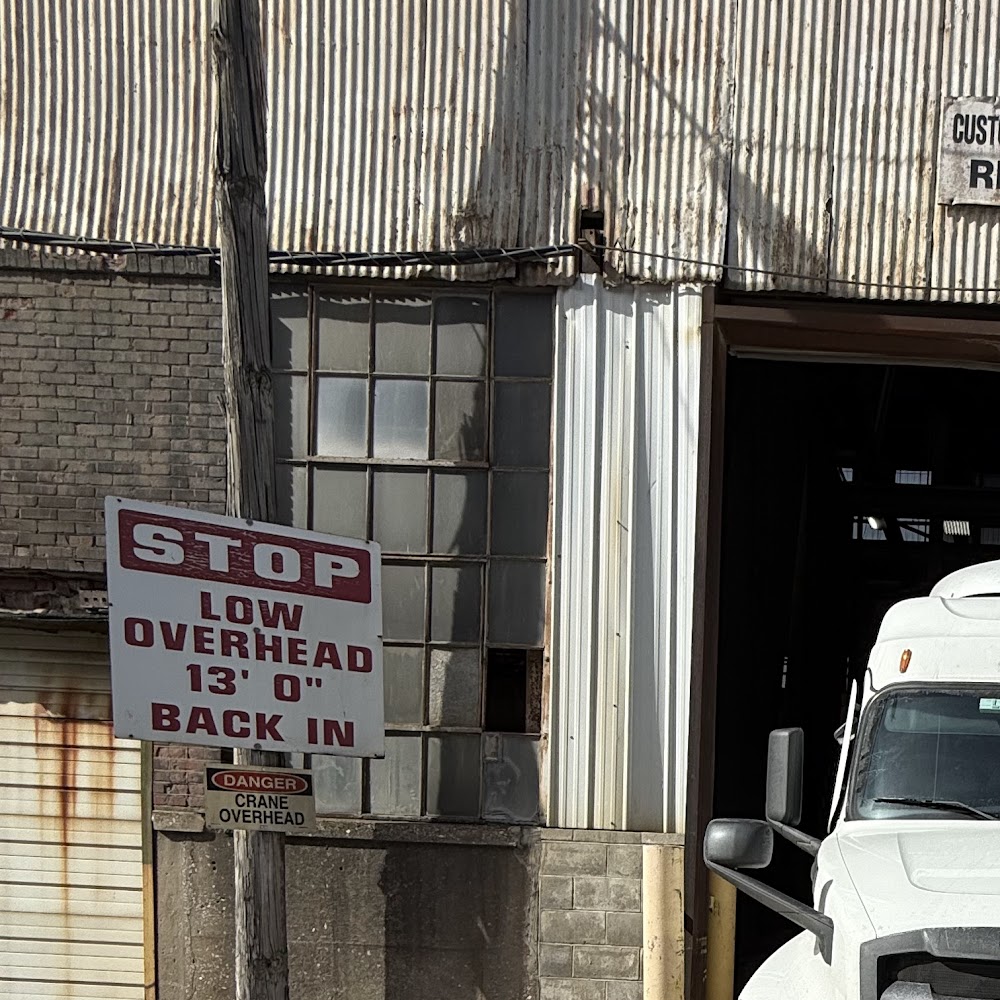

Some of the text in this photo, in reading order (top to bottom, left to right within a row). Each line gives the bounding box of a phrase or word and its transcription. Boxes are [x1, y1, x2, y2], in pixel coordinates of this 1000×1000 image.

[132, 523, 360, 589] STOP
[200, 591, 303, 631] LOW
[124, 617, 373, 673] OVERHEAD
[186, 663, 322, 703] 13' 0"
[151, 702, 355, 747] BACK IN
[223, 774, 297, 790] DANGER
[235, 793, 289, 810] CRANE
[219, 808, 305, 825] OVERHEAD
